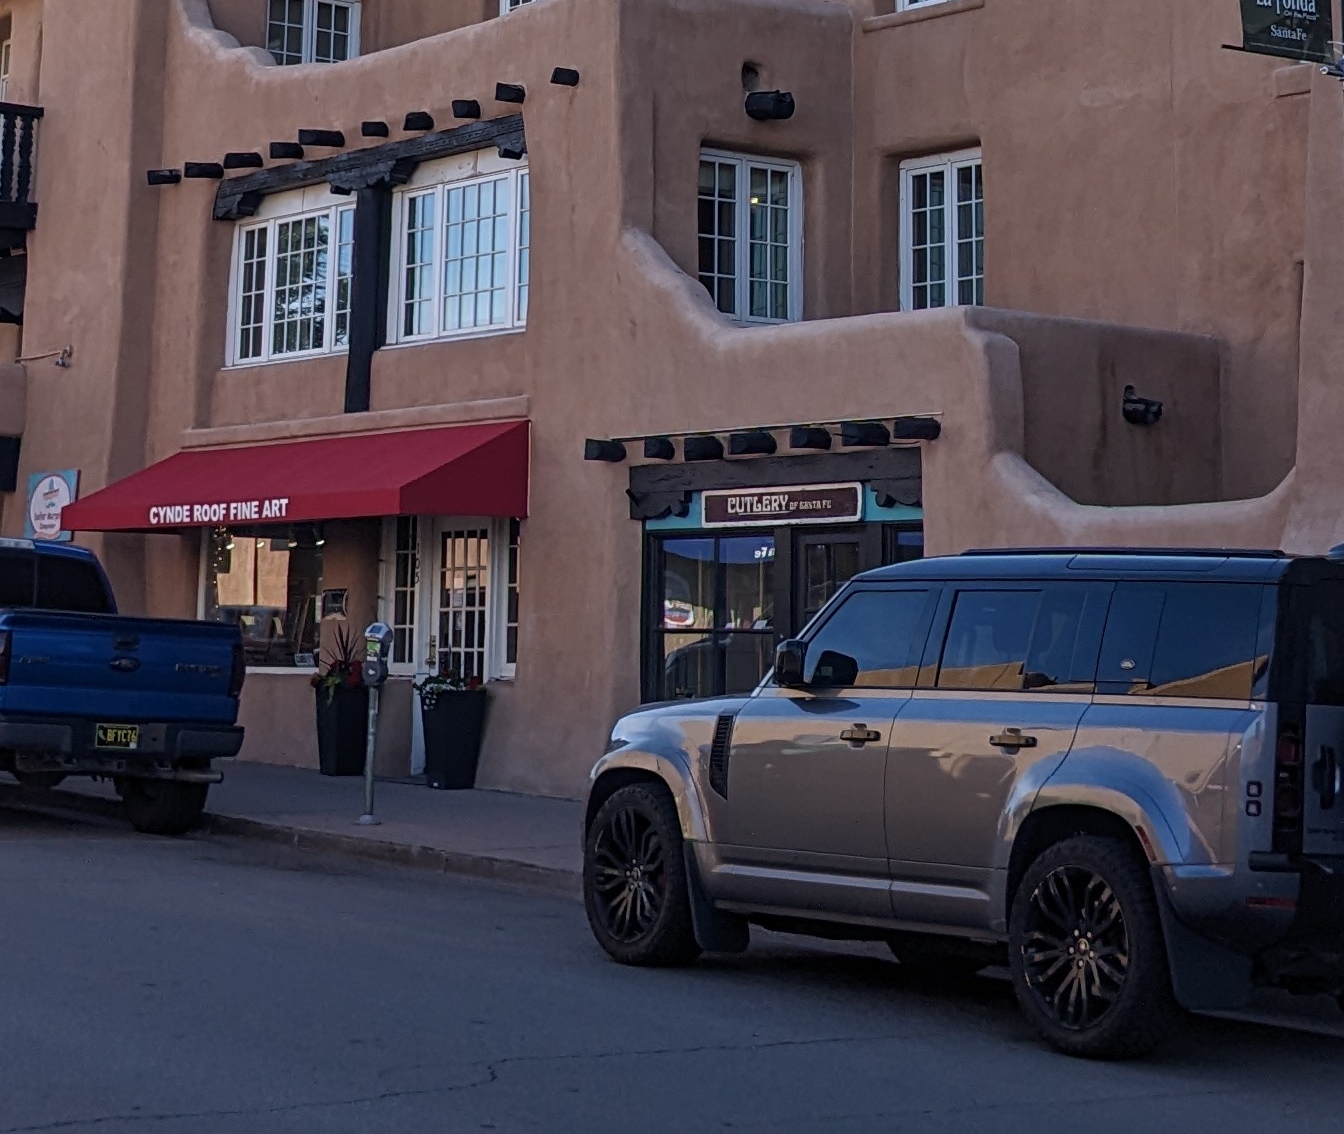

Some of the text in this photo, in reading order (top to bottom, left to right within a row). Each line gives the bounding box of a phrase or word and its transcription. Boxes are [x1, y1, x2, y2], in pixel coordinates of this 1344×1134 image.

[149, 498, 289, 525] CYNDE ROOF FINE ART
[727, 494, 789, 514] CUTLERY
